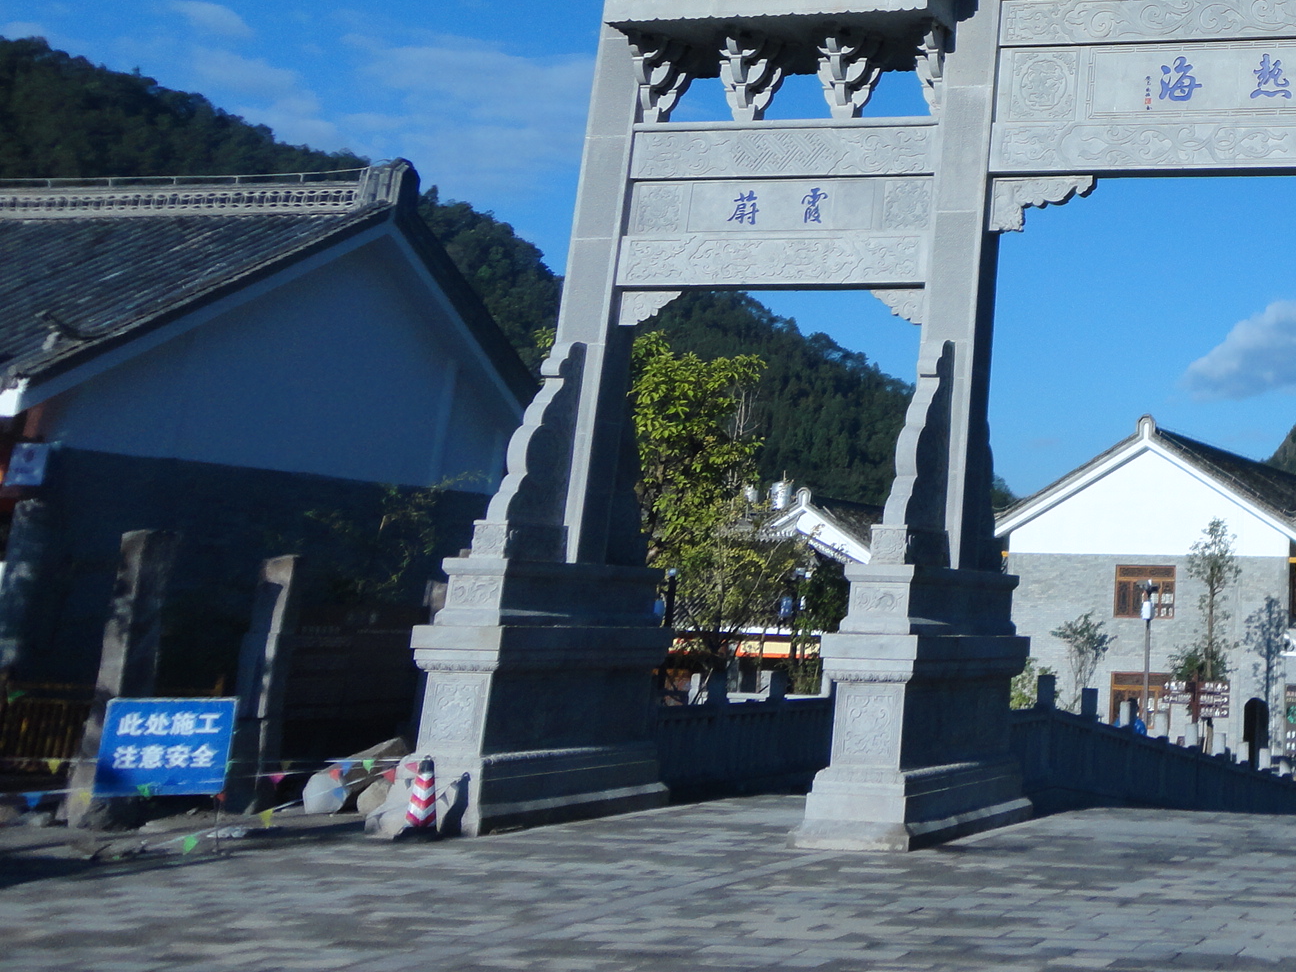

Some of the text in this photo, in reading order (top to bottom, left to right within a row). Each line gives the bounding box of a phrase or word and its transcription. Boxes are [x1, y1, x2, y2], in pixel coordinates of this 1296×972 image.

[116, 711, 223, 737] 此处施工
[112, 743, 219, 770] 注意安全
